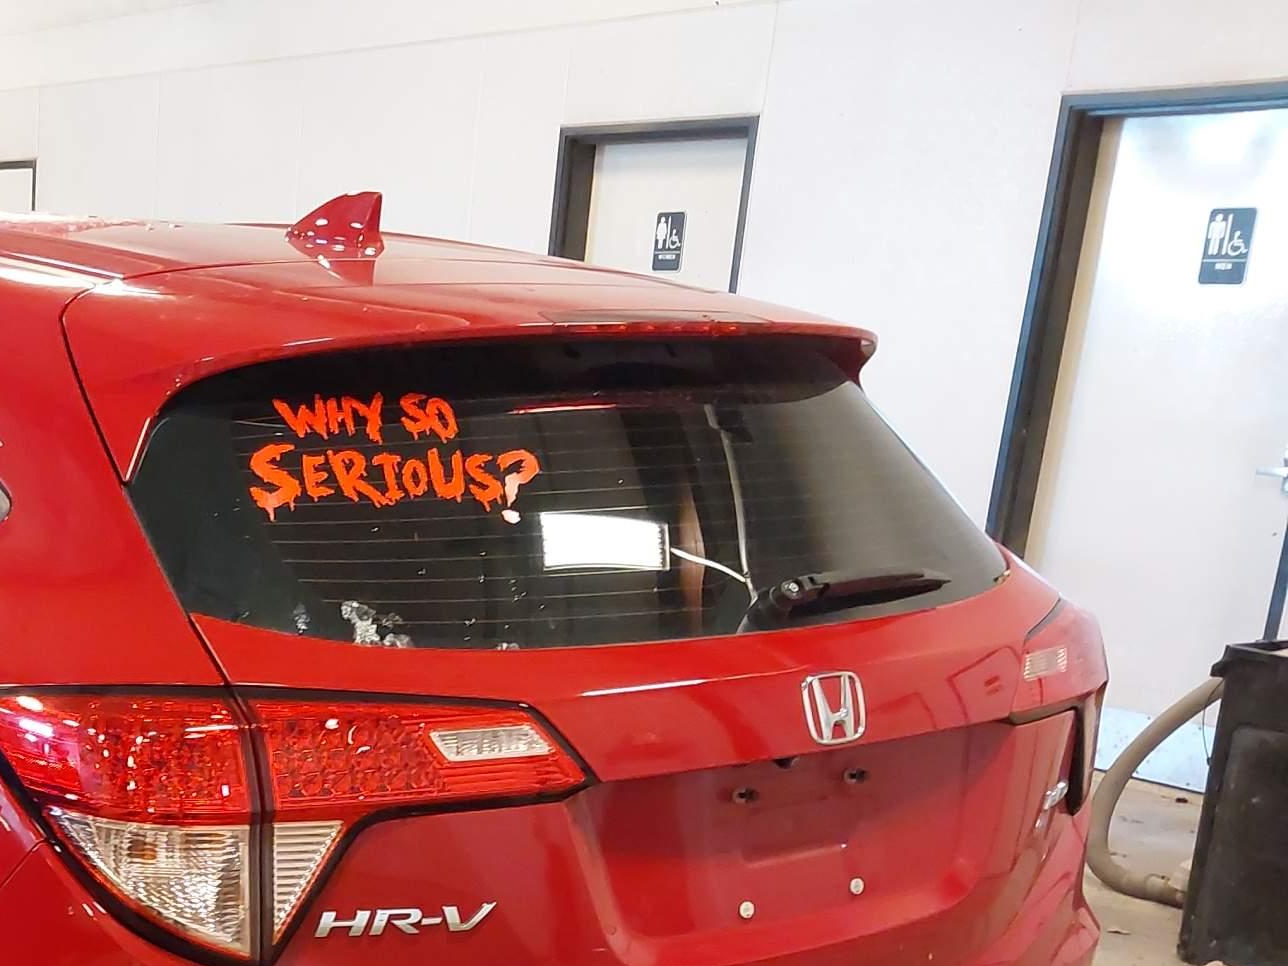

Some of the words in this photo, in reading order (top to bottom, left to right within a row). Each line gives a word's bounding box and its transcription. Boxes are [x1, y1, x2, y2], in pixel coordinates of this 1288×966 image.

[272, 391, 383, 446] WHY
[399, 393, 460, 444] SO
[248, 443, 541, 525] SERIOUS?
[314, 901, 497, 938] HR-V
